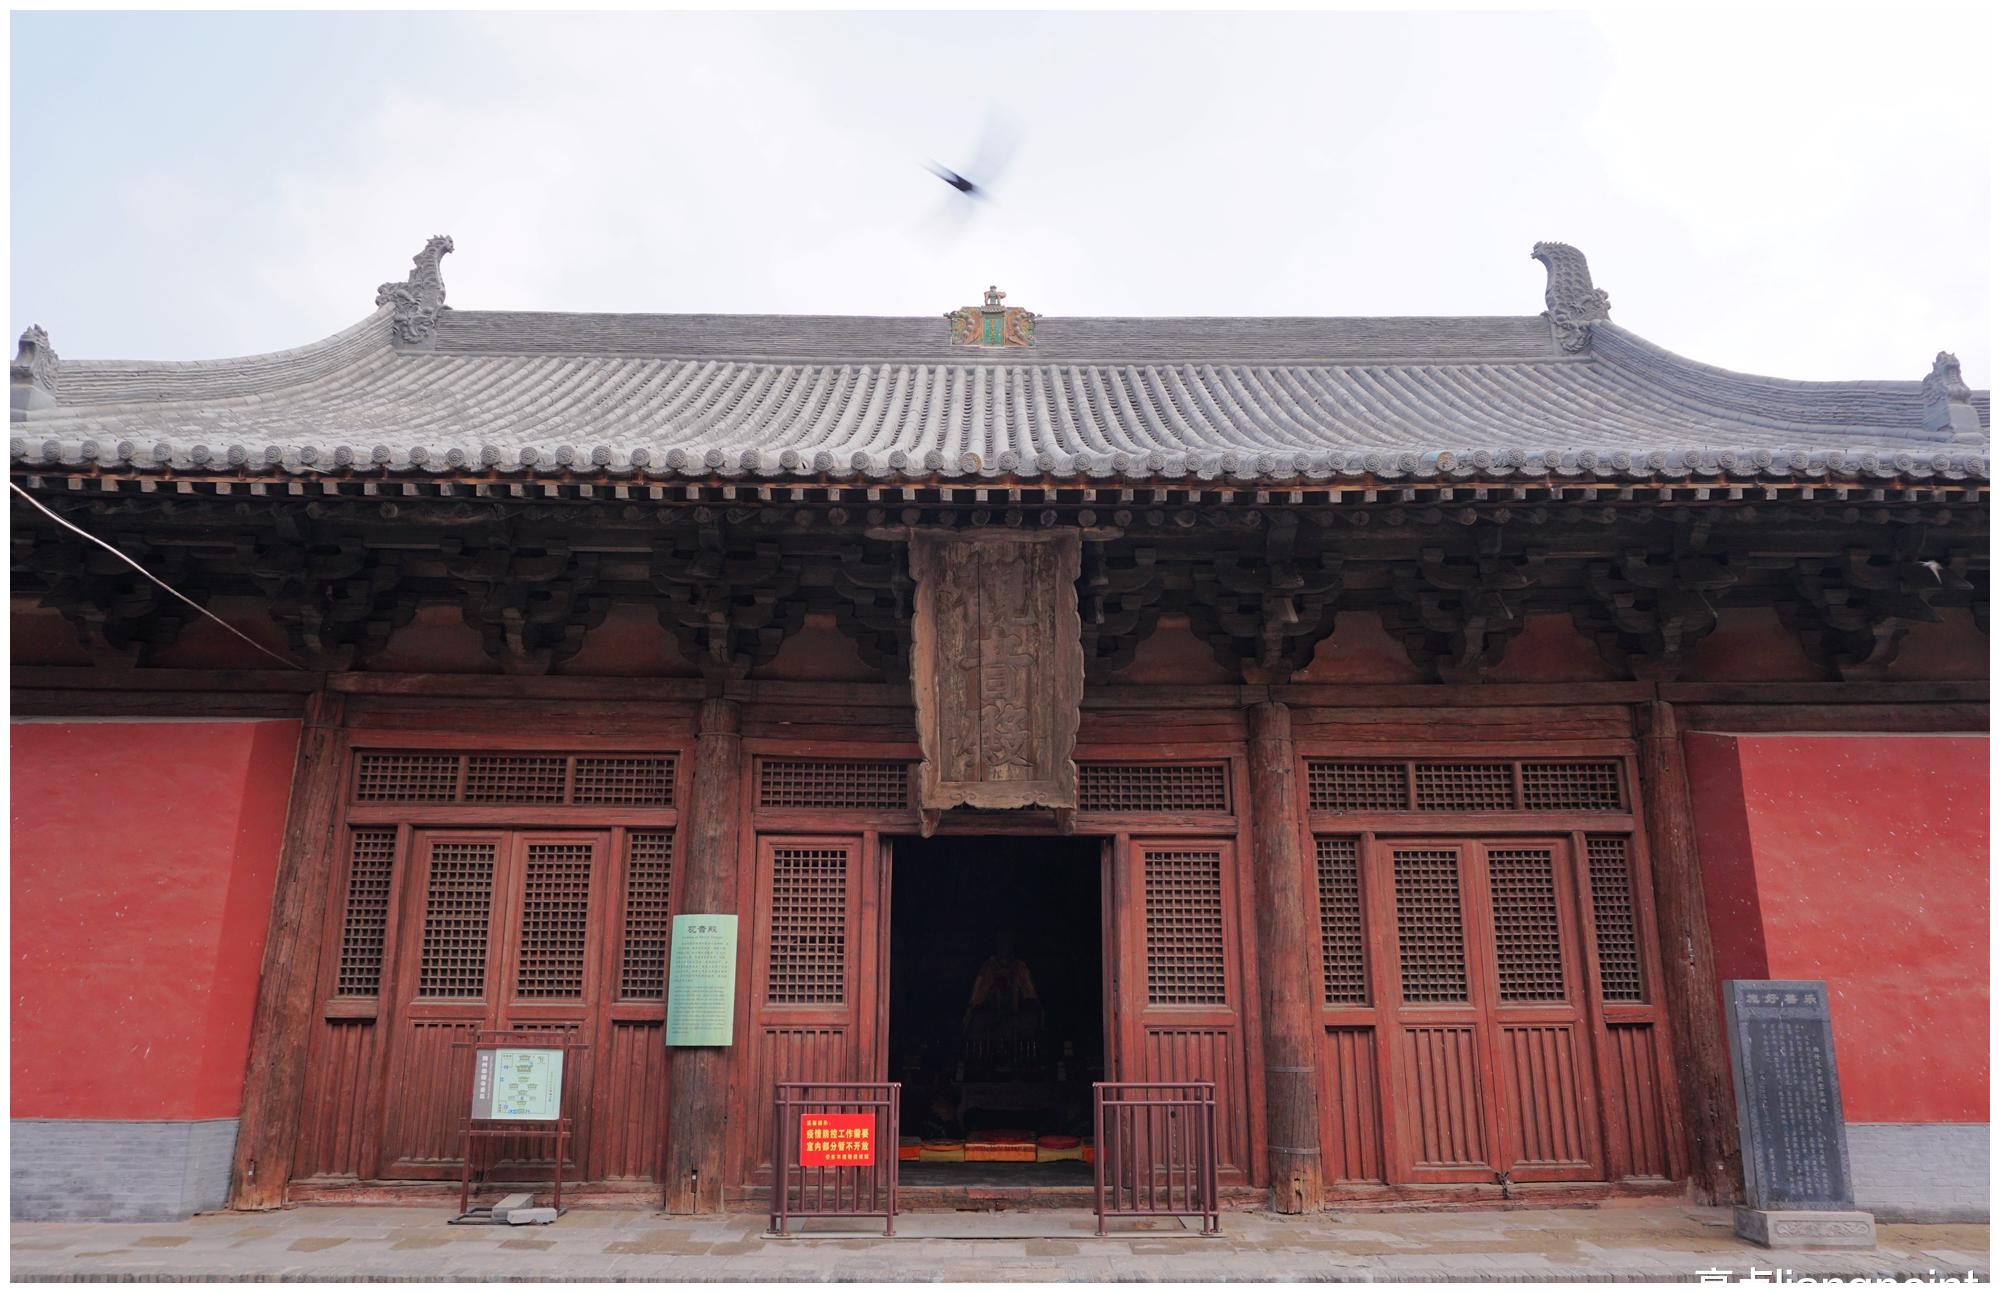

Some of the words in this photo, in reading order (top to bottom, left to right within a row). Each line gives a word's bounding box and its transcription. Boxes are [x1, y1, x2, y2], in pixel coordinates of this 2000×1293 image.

[806, 1128, 869, 1139] 疫情防控工作需要
[806, 1141, 869, 1152] 室内部分暂不开放
